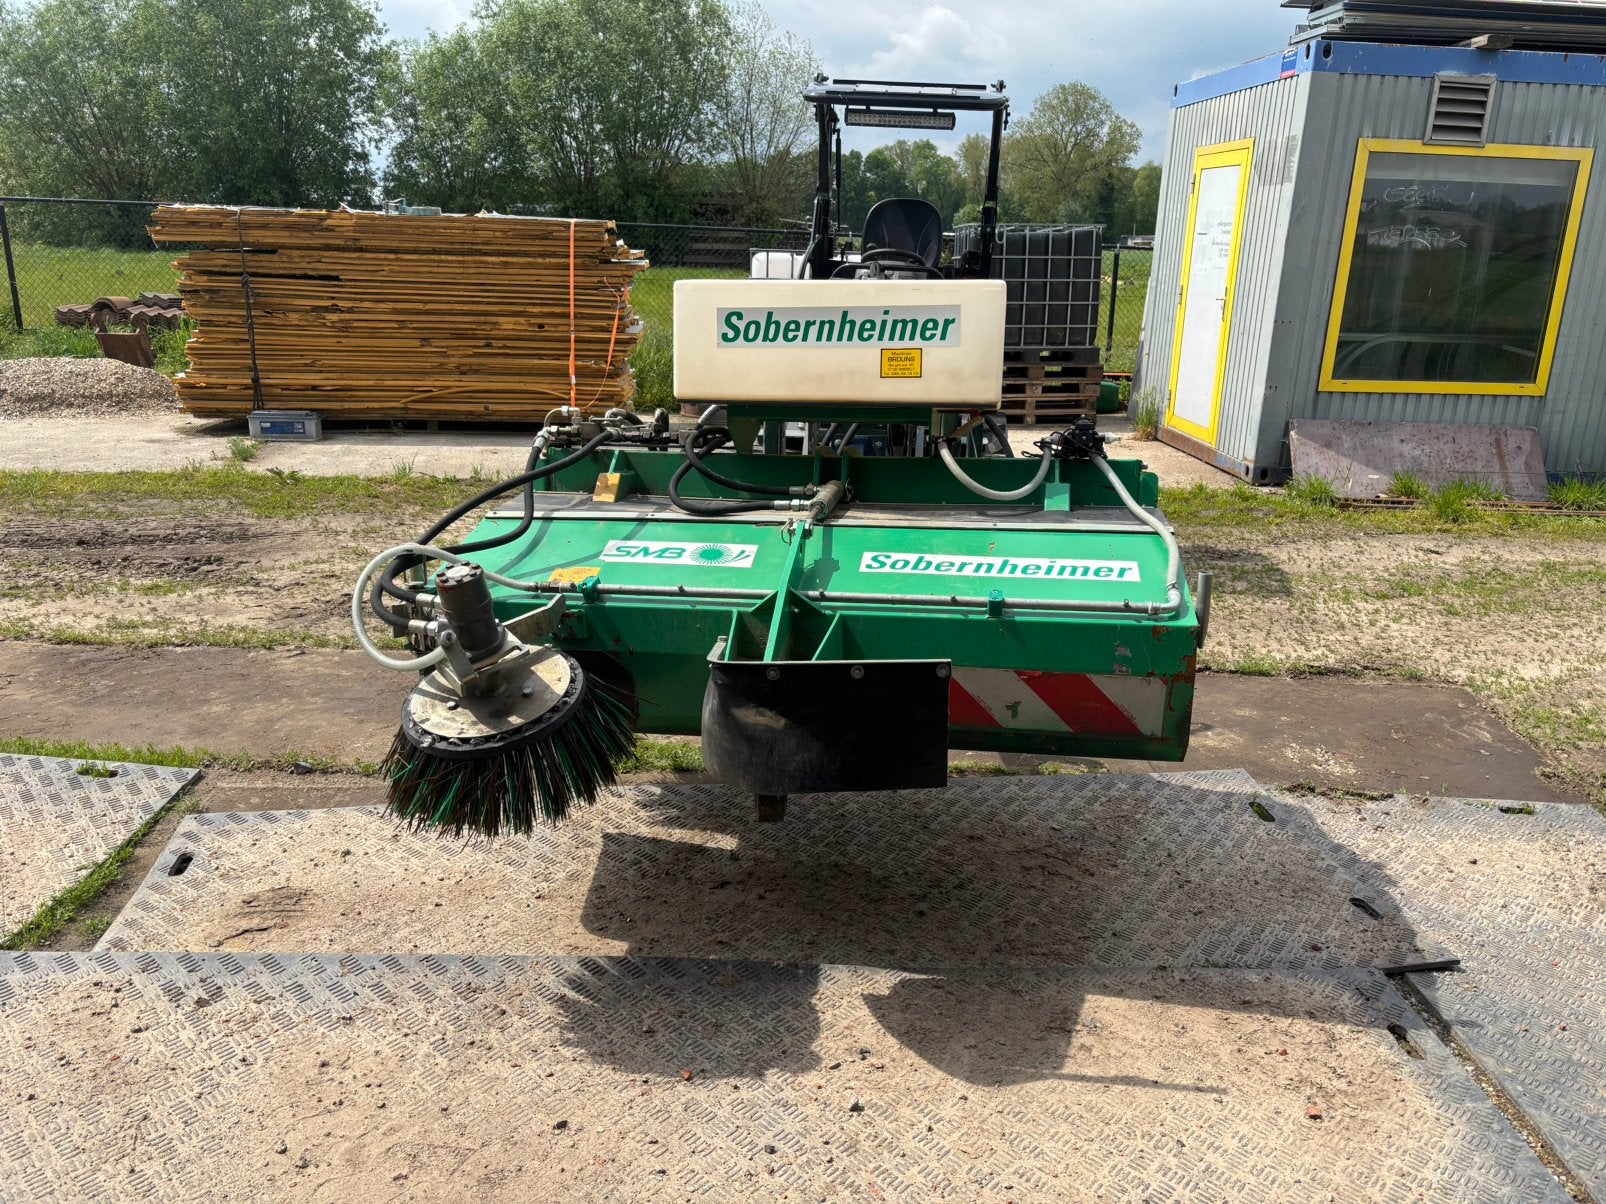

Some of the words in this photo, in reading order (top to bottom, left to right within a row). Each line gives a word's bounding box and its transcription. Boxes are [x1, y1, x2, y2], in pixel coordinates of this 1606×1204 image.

[721, 309, 956, 343] Sobernheimer
[602, 545, 687, 559] SMB
[865, 553, 1133, 579] Sobernheimer
